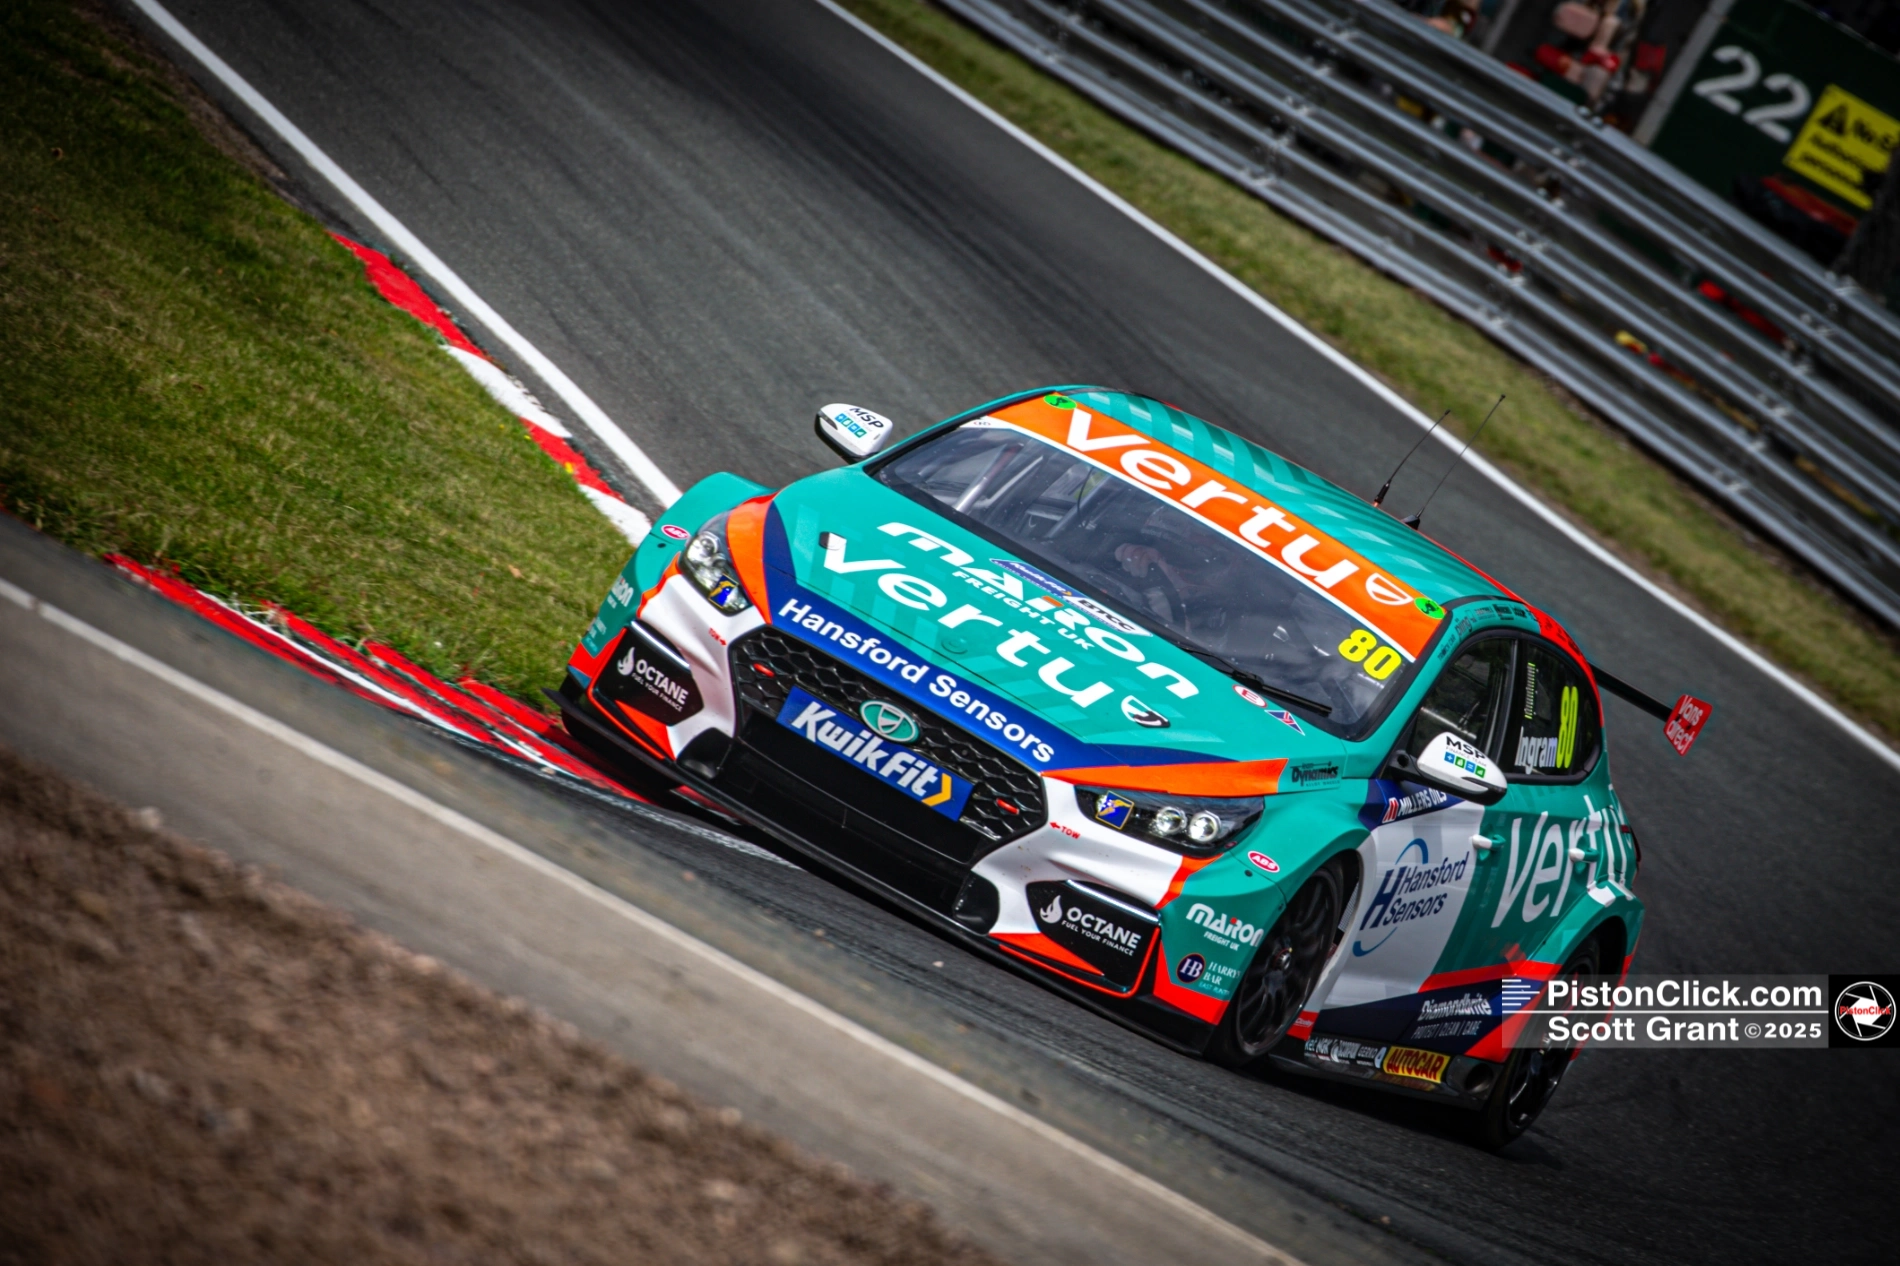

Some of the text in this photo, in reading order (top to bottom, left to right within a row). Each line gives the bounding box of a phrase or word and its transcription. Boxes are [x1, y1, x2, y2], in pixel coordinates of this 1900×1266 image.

[1693, 46, 1811, 143] 22
[849, 406, 885, 429] MSP
[1066, 407, 1360, 590] vertu
[823, 532, 1115, 708] vertu
[952, 570, 1056, 625] FREIGHT
[1057, 627, 1095, 650] UK
[1078, 599, 1136, 632] BTCC
[1338, 628, 1402, 681] 80
[631, 671, 645, 686] FUEL
[659, 693, 684, 713] FINANCE
[635, 658, 689, 706] OCTANE
[778, 598, 1055, 763] Hansford Sensors
[1556, 685, 1579, 769] 80
[1678, 695, 1704, 725] Vans
[1446, 735, 1486, 760] MSP
[1514, 725, 1558, 775] Ingram
[1666, 718, 1696, 755] direct
[1396, 791, 1431, 817] MILLERS
[1060, 825, 1081, 840] TOW
[1252, 855, 1276, 870] ABS
[1401, 852, 1470, 896] Hansford
[1066, 906, 1142, 950] OCTANE
[1382, 892, 1448, 927] Sensors
[1061, 919, 1135, 957] FUEL YOUR FINANCE
[1203, 931, 1241, 951] FREIGHT UK
[1203, 972, 1223, 986] BAR
[1386, 1048, 1445, 1081] AUTOCAR
